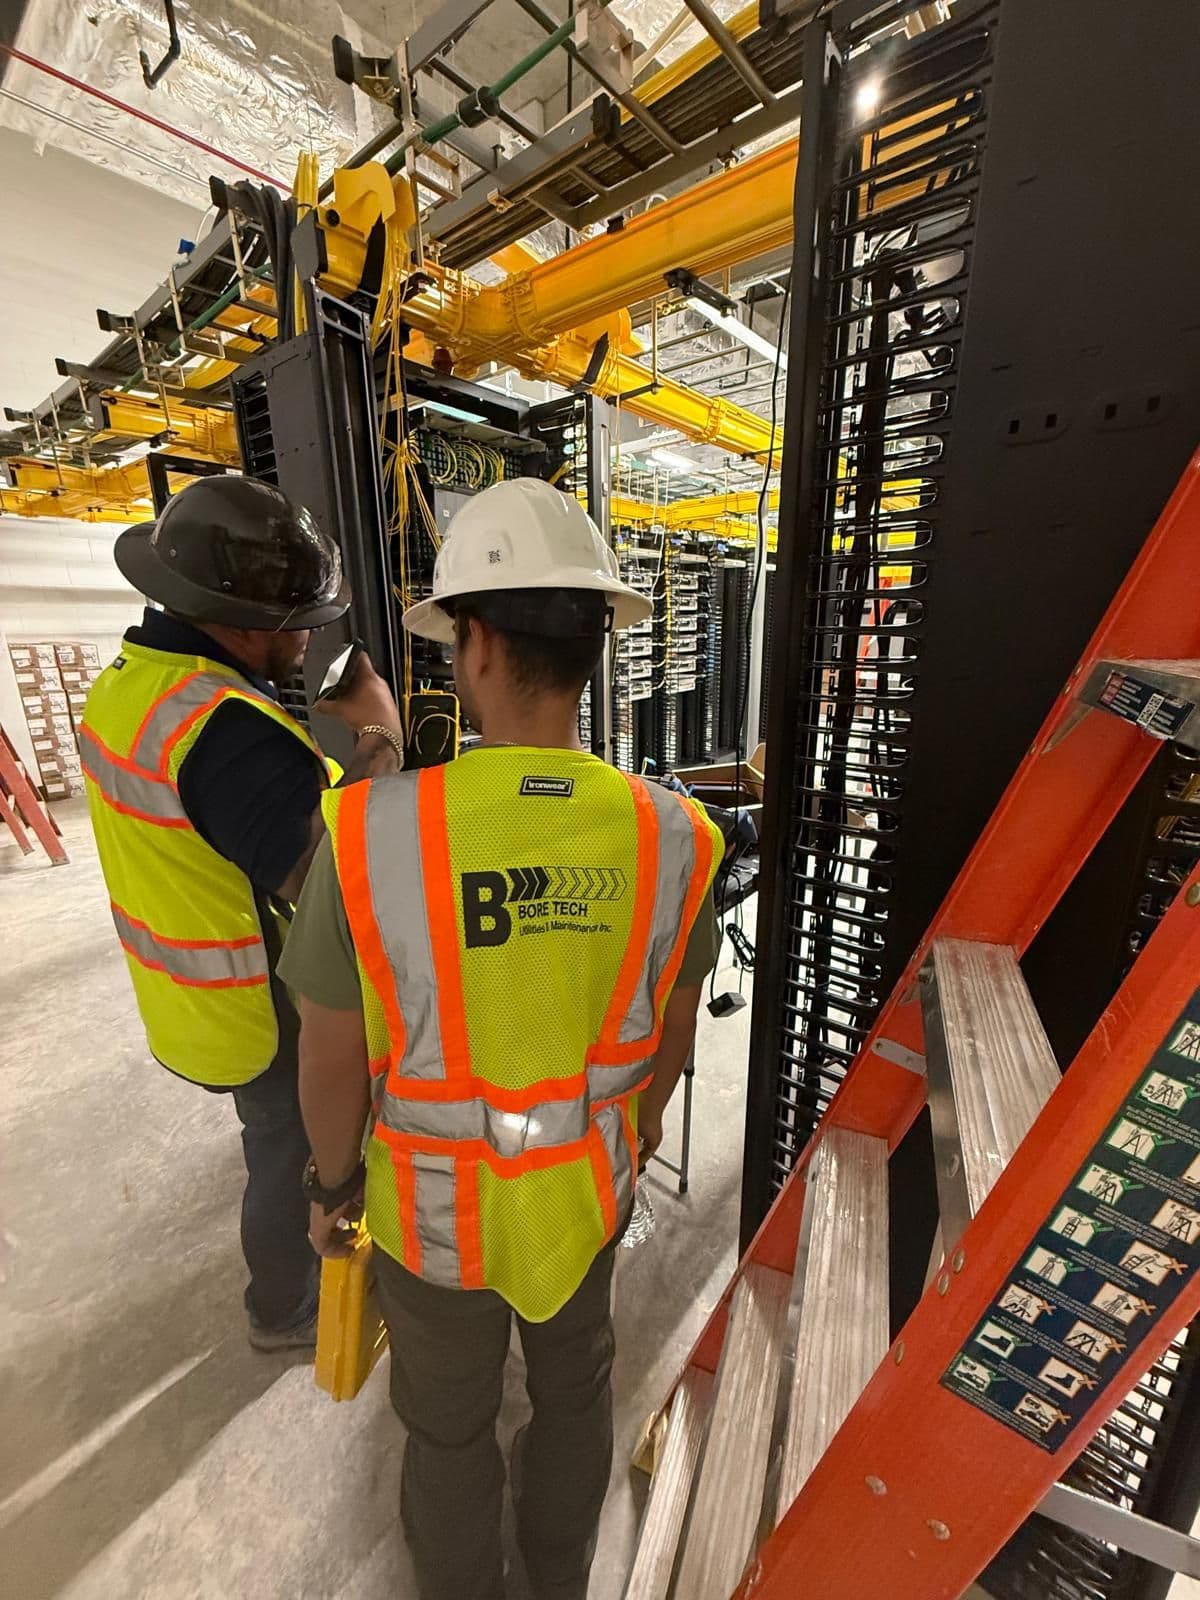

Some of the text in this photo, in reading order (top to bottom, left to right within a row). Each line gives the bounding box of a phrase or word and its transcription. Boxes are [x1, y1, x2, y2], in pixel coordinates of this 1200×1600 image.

[461, 870, 512, 949] B
[518, 901, 588, 919] BORE TECH
